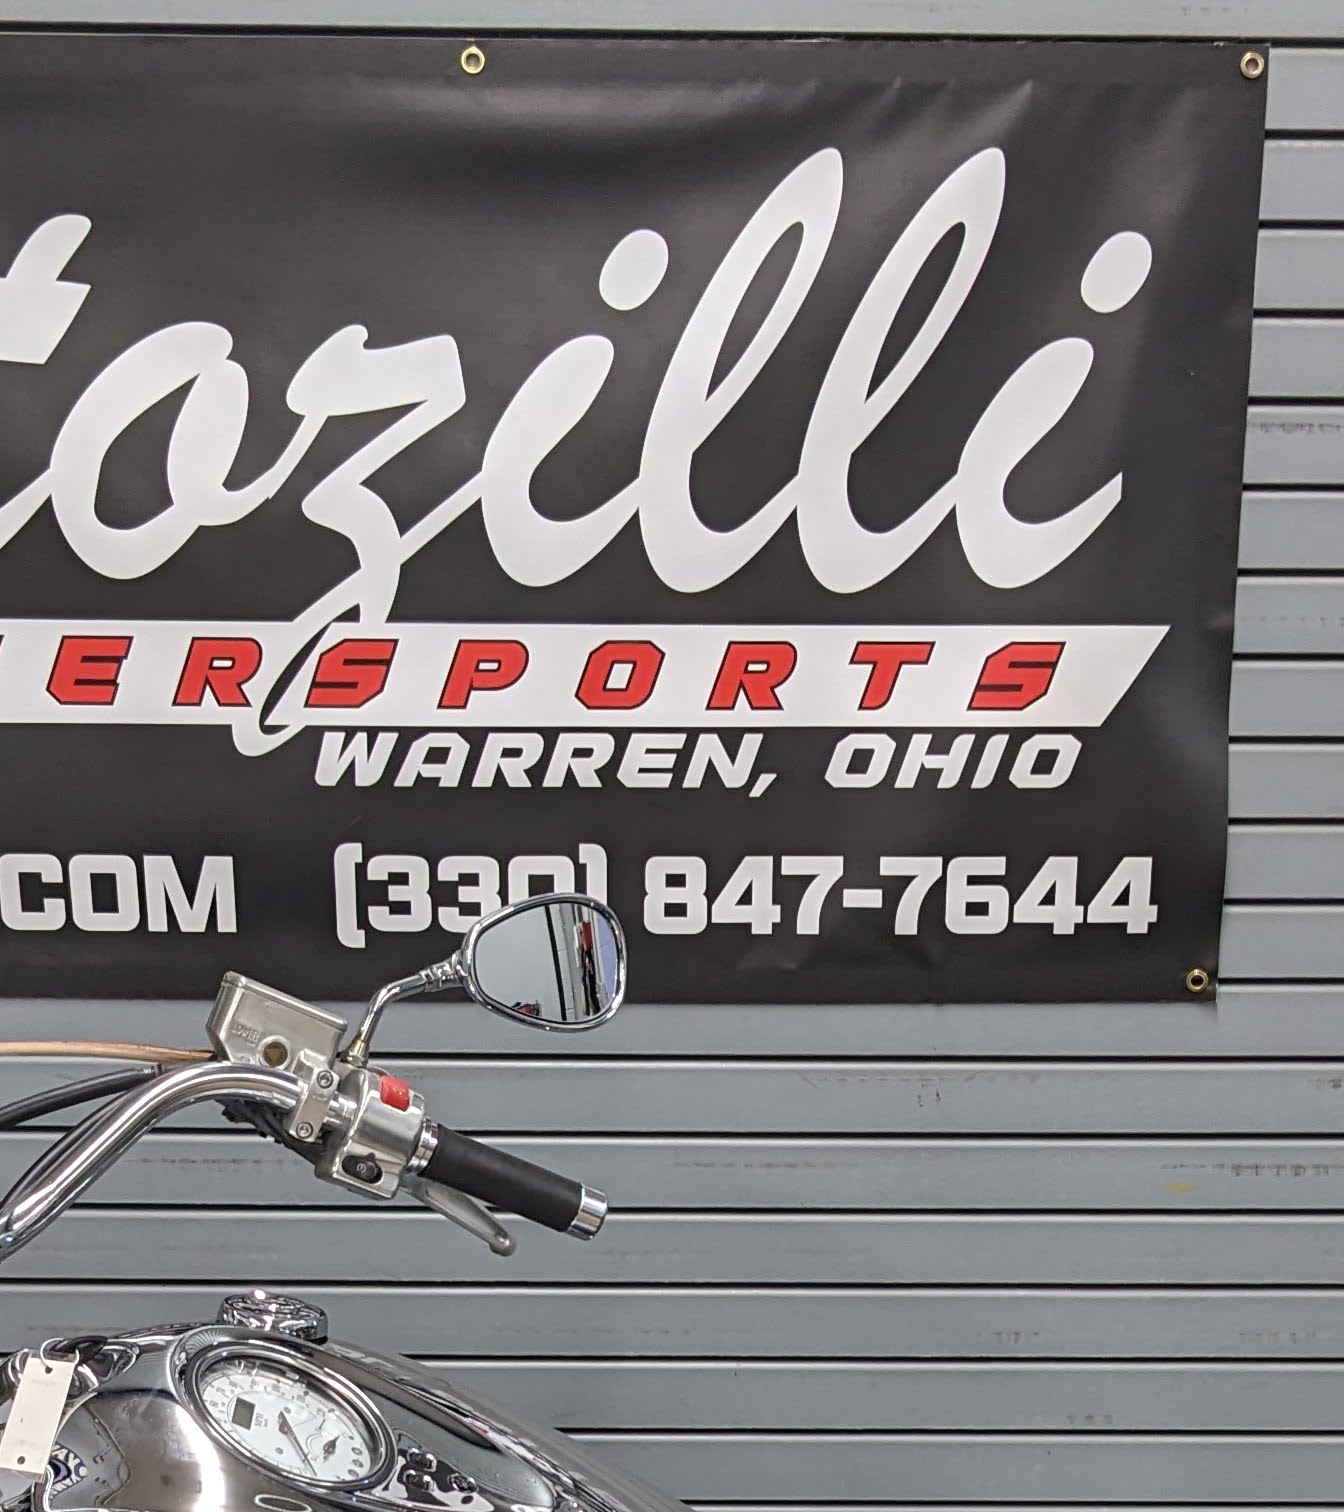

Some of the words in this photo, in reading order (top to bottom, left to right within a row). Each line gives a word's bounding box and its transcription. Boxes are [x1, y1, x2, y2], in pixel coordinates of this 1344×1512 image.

[314, 731, 776, 798] WARREN,
[824, 733, 1083, 789] OHIO
[643, 855, 1158, 936] 847-7644
